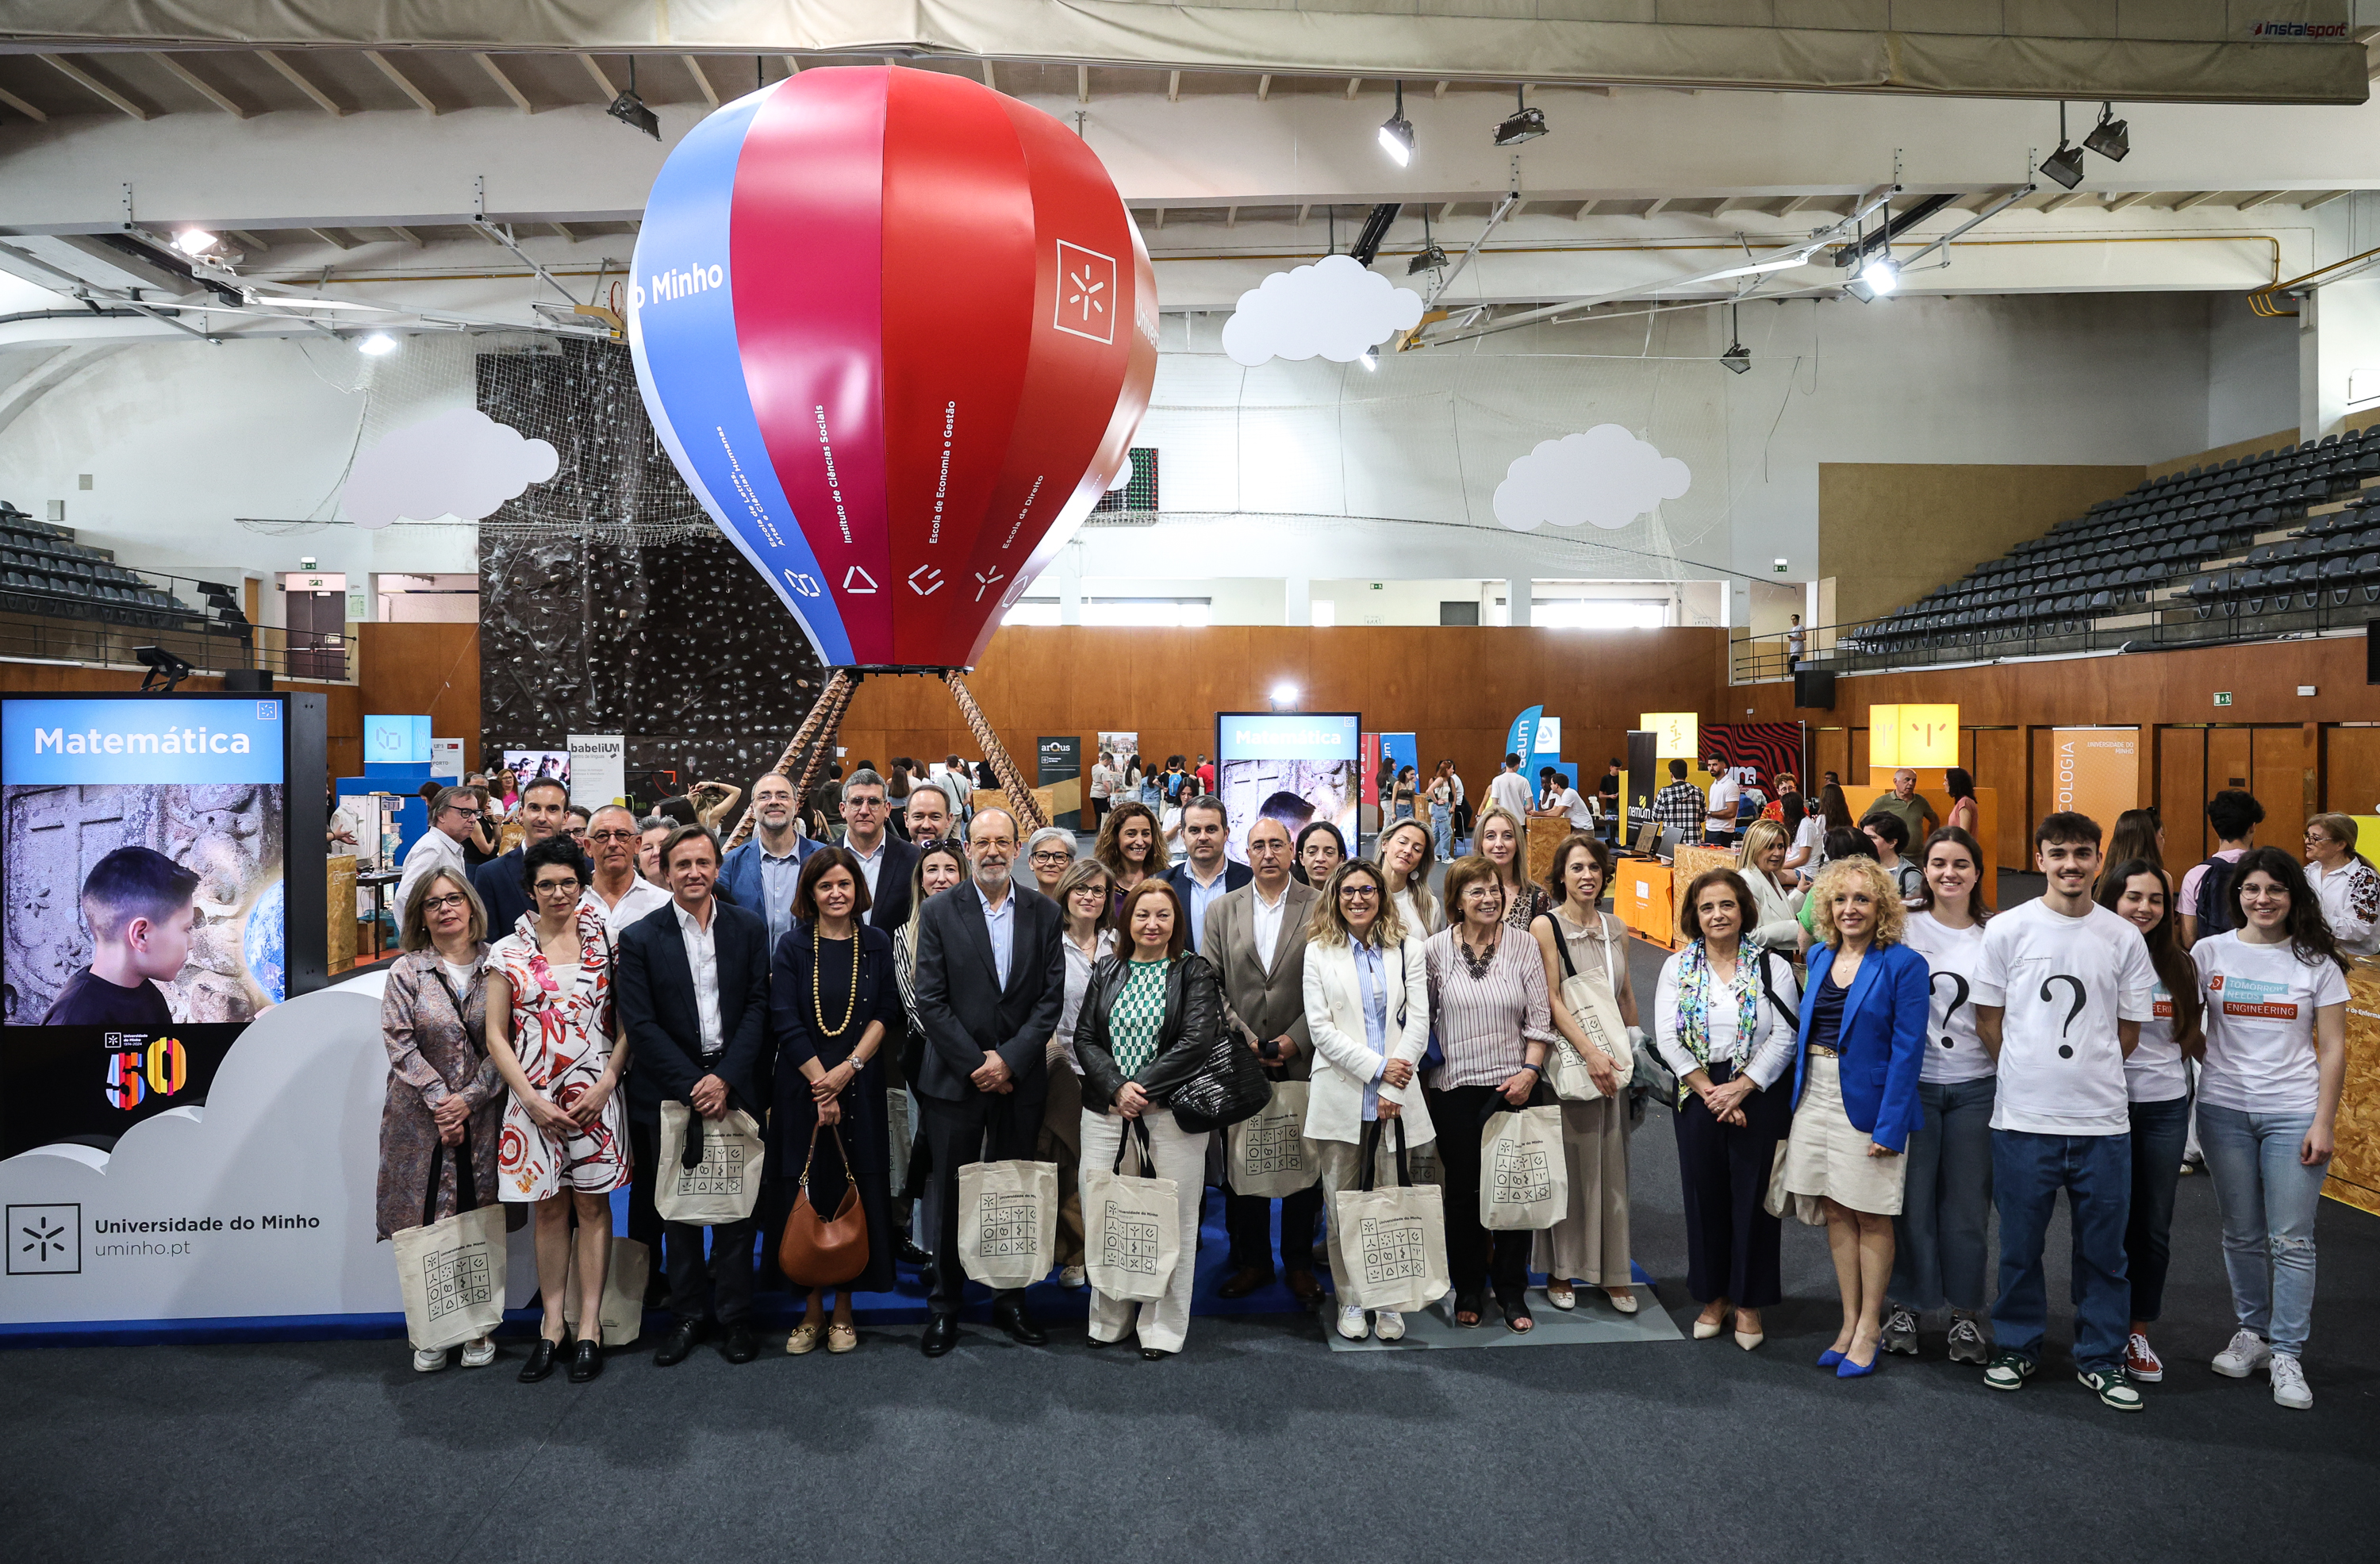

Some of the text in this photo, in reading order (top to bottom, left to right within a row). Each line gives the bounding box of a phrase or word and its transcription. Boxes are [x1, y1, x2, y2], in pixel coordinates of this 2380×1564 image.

[2264, 21, 2347, 39] instalsport
[652, 262, 724, 305] Minho
[943, 401, 956, 437] Gestão
[716, 425, 742, 473] Humanas
[815, 405, 853, 544] Instituto de Ciências Sociais
[936, 450, 951, 498] Economia
[739, 474, 764, 513] Ciências
[935, 501, 943, 513] de
[730, 471, 778, 548] Escola de Letras,
[1002, 475, 1043, 549] Escola de Direito
[767, 522, 786, 546] Artes
[929, 515, 942, 544] Escola
[34, 725, 251, 755] Matemática
[1235, 729, 1342, 744] Matemática
[2227, 991, 2259, 1000] NEEDS
[2229, 980, 2285, 993] TOMORROW
[2226, 1003, 2294, 1016] ENGINEERING
[106, 1037, 186, 1111] 50
[95, 1213, 321, 1234] Universidade do Minho
[95, 1240, 191, 1258] uminho.pt
